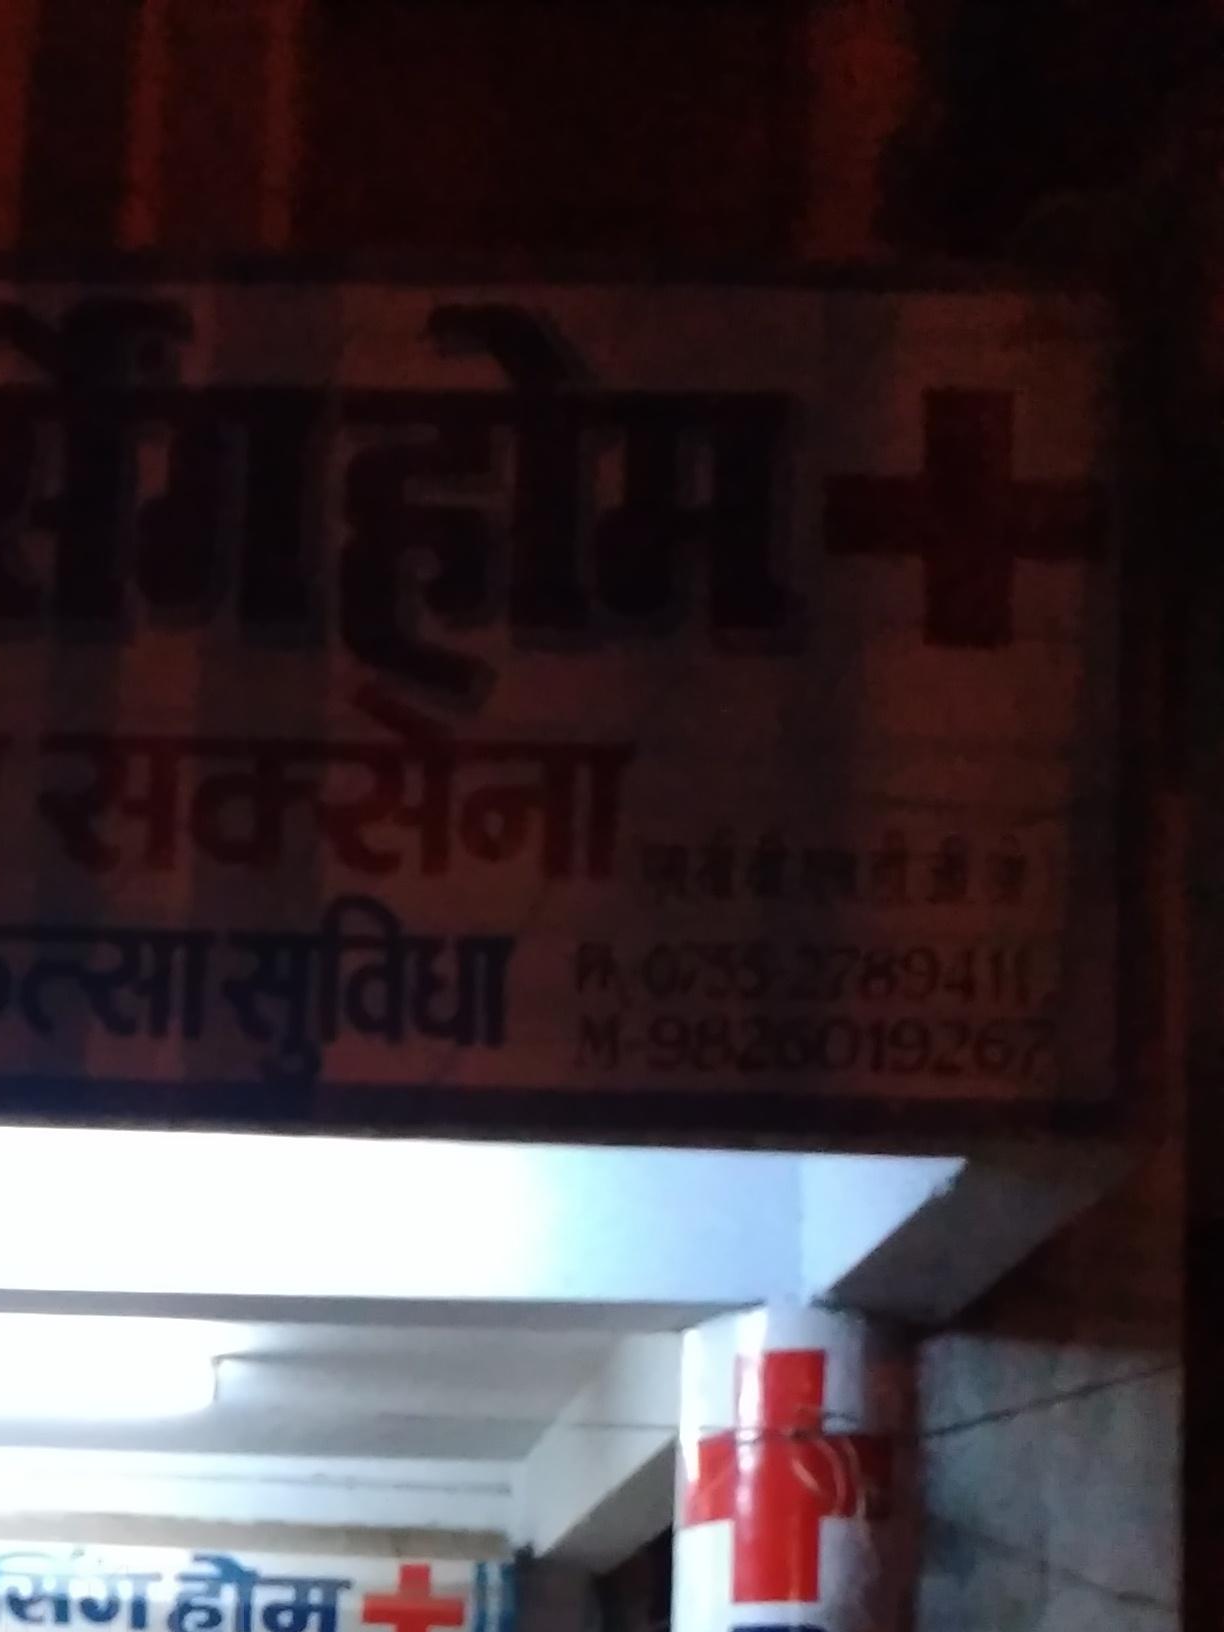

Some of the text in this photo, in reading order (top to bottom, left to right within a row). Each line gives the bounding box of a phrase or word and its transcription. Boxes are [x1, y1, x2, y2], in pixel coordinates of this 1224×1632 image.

[328, 303, 798, 712] होम
[38, 685, 636, 881] सक्सेना
[221, 893, 516, 1088] सुविधा
